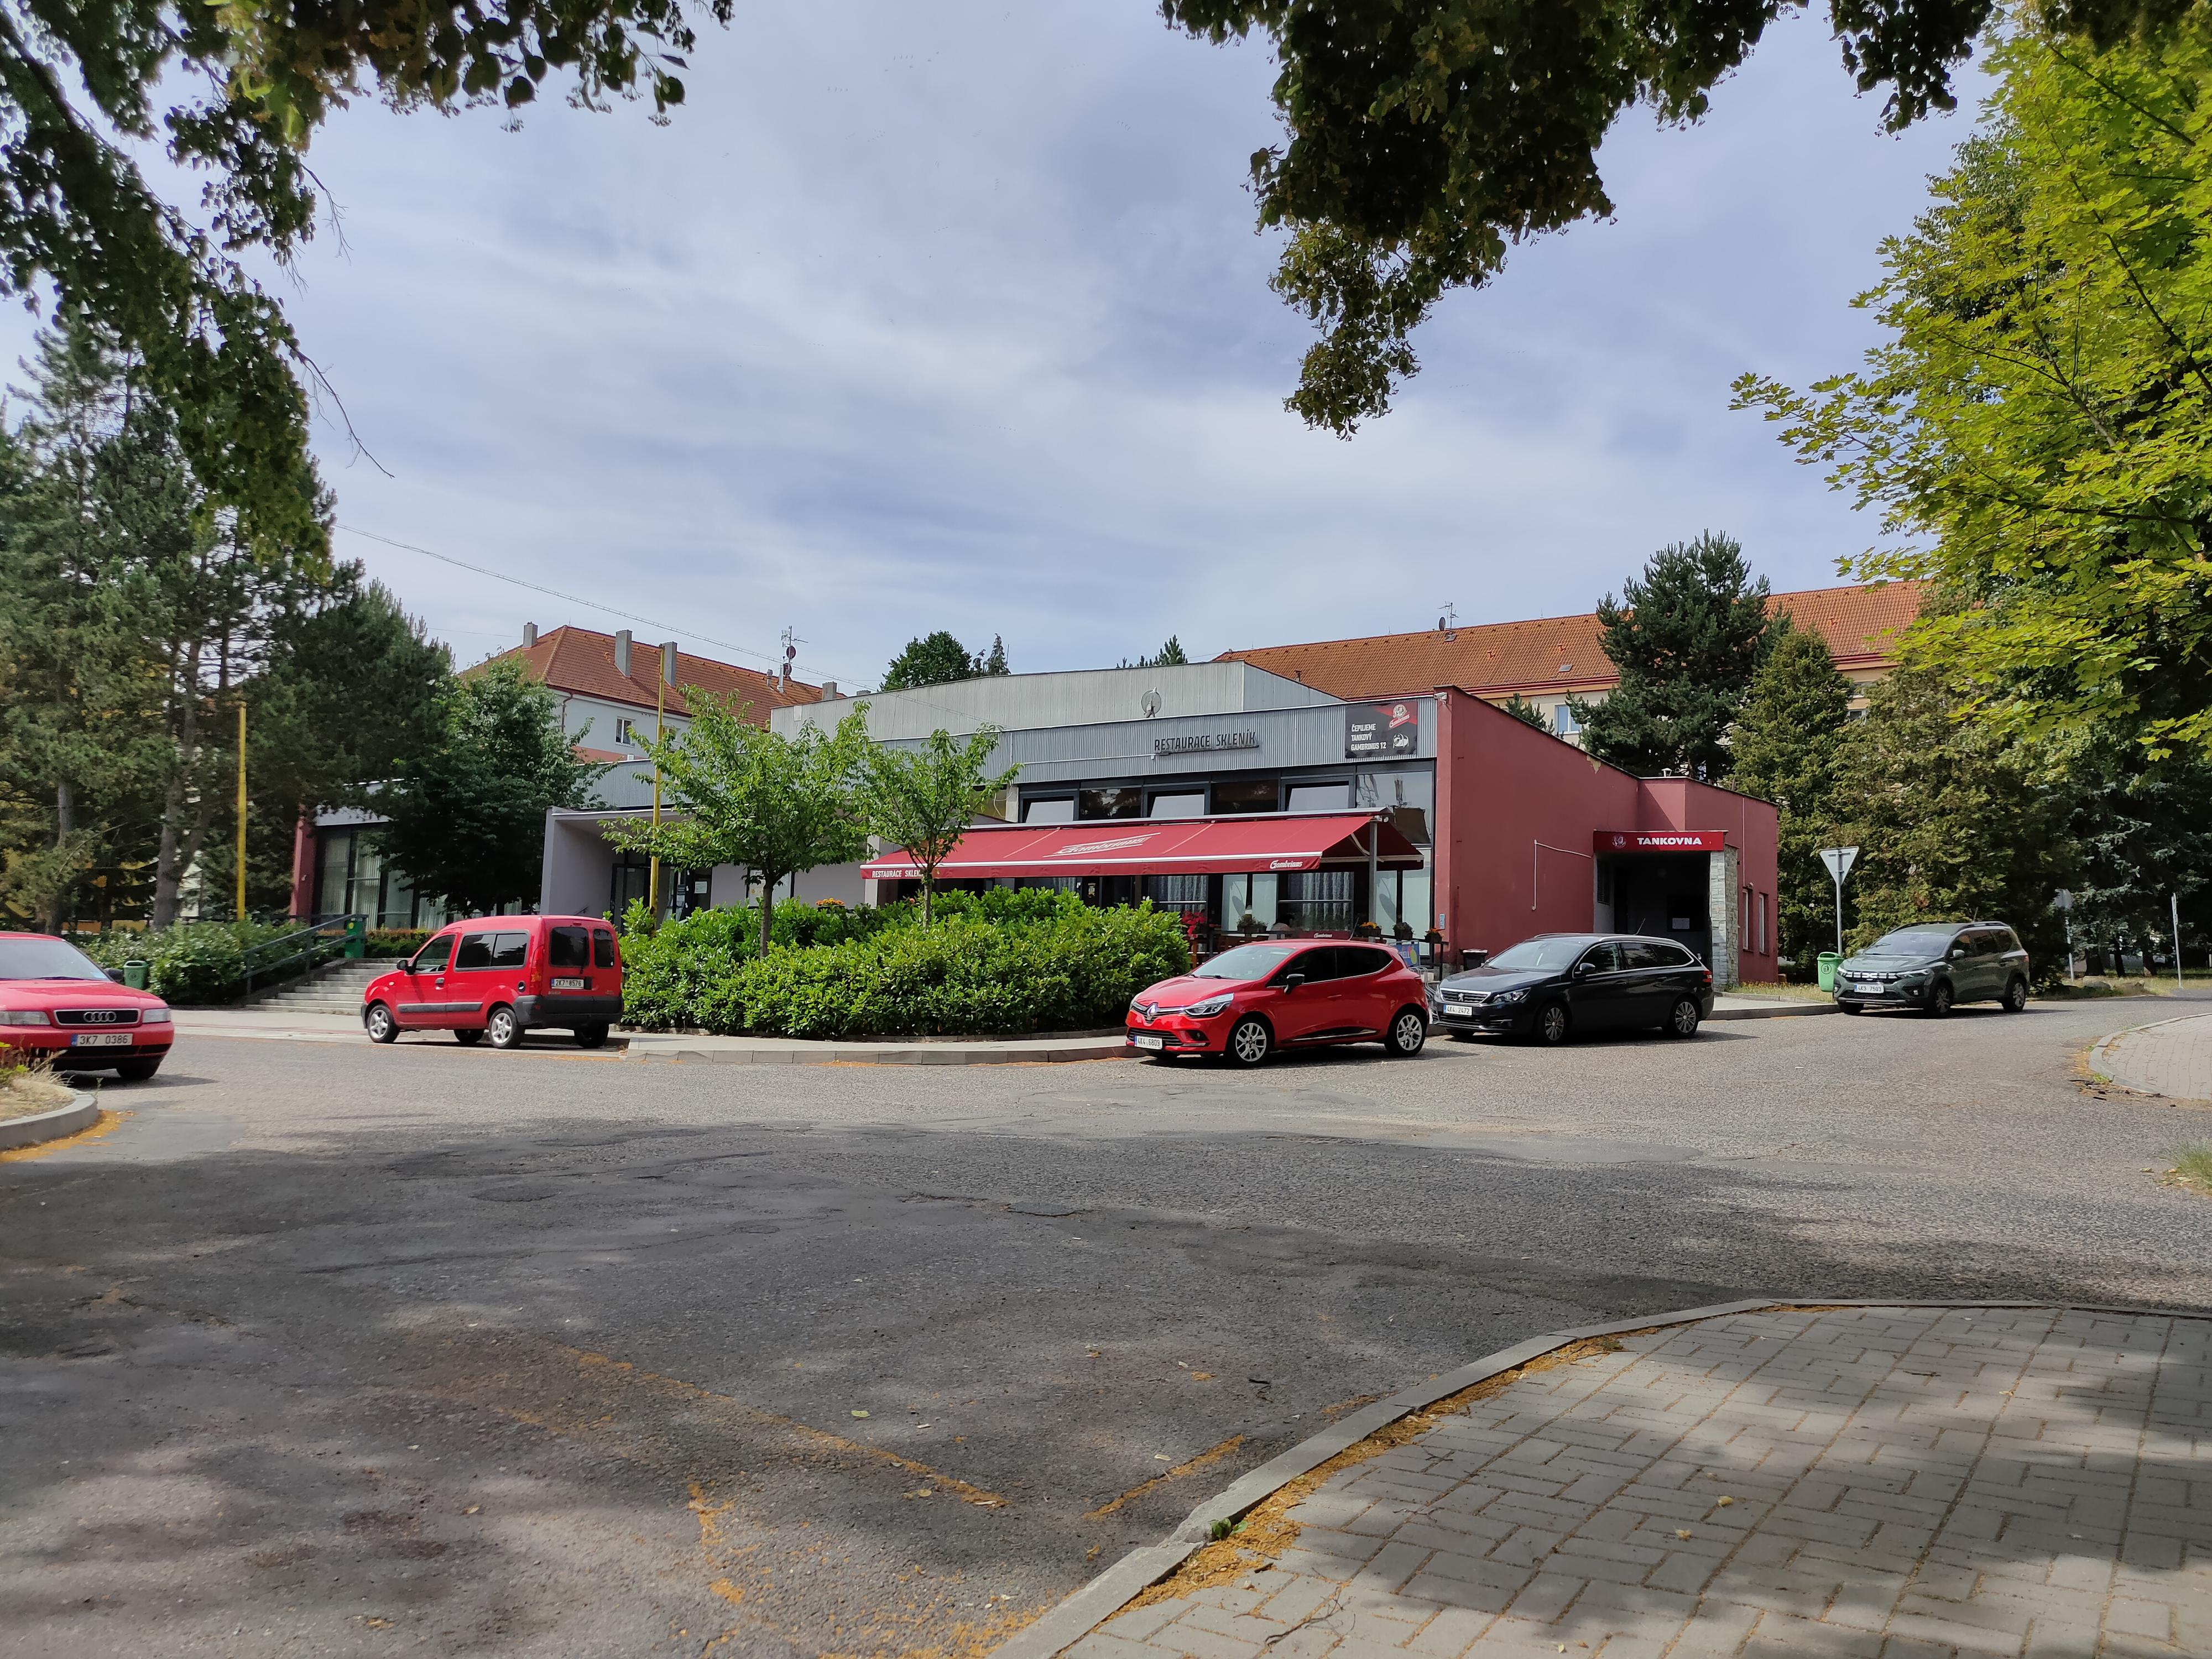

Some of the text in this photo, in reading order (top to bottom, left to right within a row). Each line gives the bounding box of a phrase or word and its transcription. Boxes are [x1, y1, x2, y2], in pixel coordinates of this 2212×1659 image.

[1351, 723, 1376, 732] ČEPUJEME
[1154, 729, 1255, 751] RESTAURACE SKLENÍK
[1351, 732, 1372, 742] TANKOVÝ
[1351, 742, 1379, 751] GAMBRINUS
[1637, 837, 1702, 846] TANKOVNA
[1270, 859, 1303, 869] Gambrinus
[872, 870, 902, 878] RESTAURACE
[79, 1035, 98, 1045] 3K7
[105, 1035, 128, 1045] 0386
